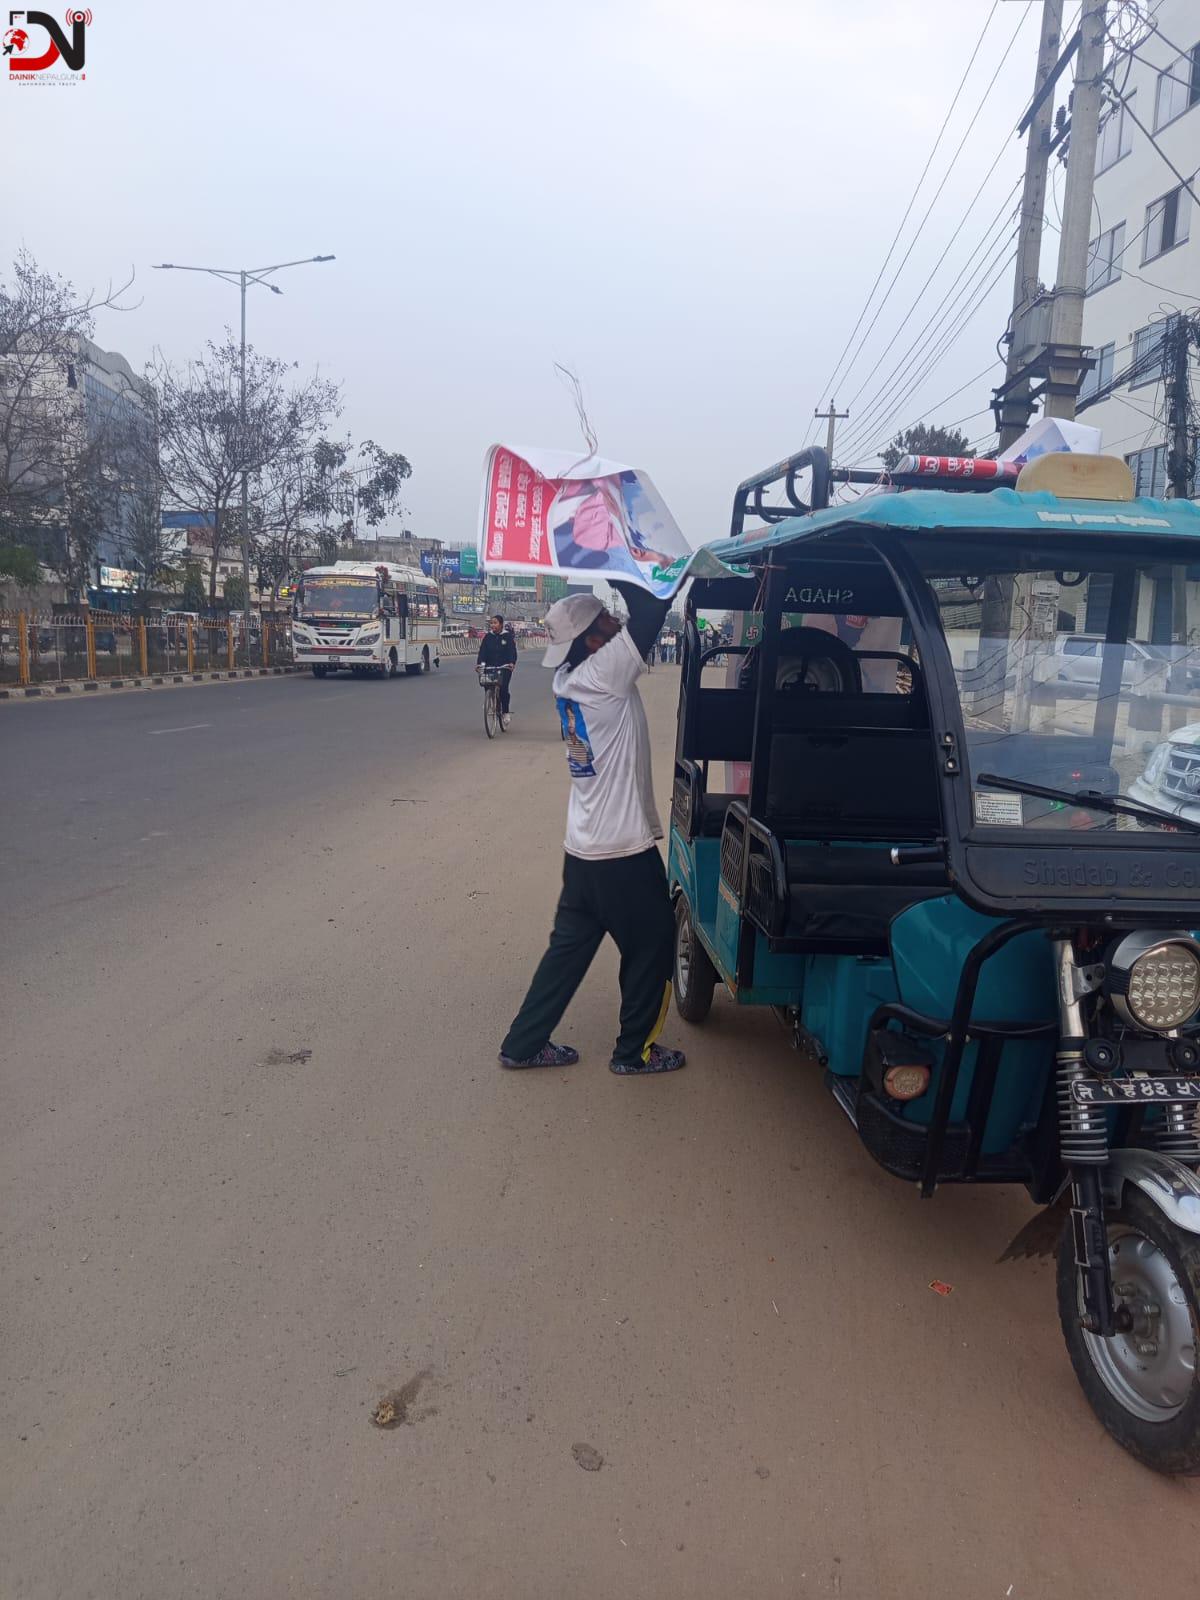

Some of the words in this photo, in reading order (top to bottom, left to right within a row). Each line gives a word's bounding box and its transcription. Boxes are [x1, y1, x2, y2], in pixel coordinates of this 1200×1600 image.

[1023, 859, 1118, 886] Shadab
[1128, 863, 1153, 888] &
[1165, 862, 1200, 889] Co
